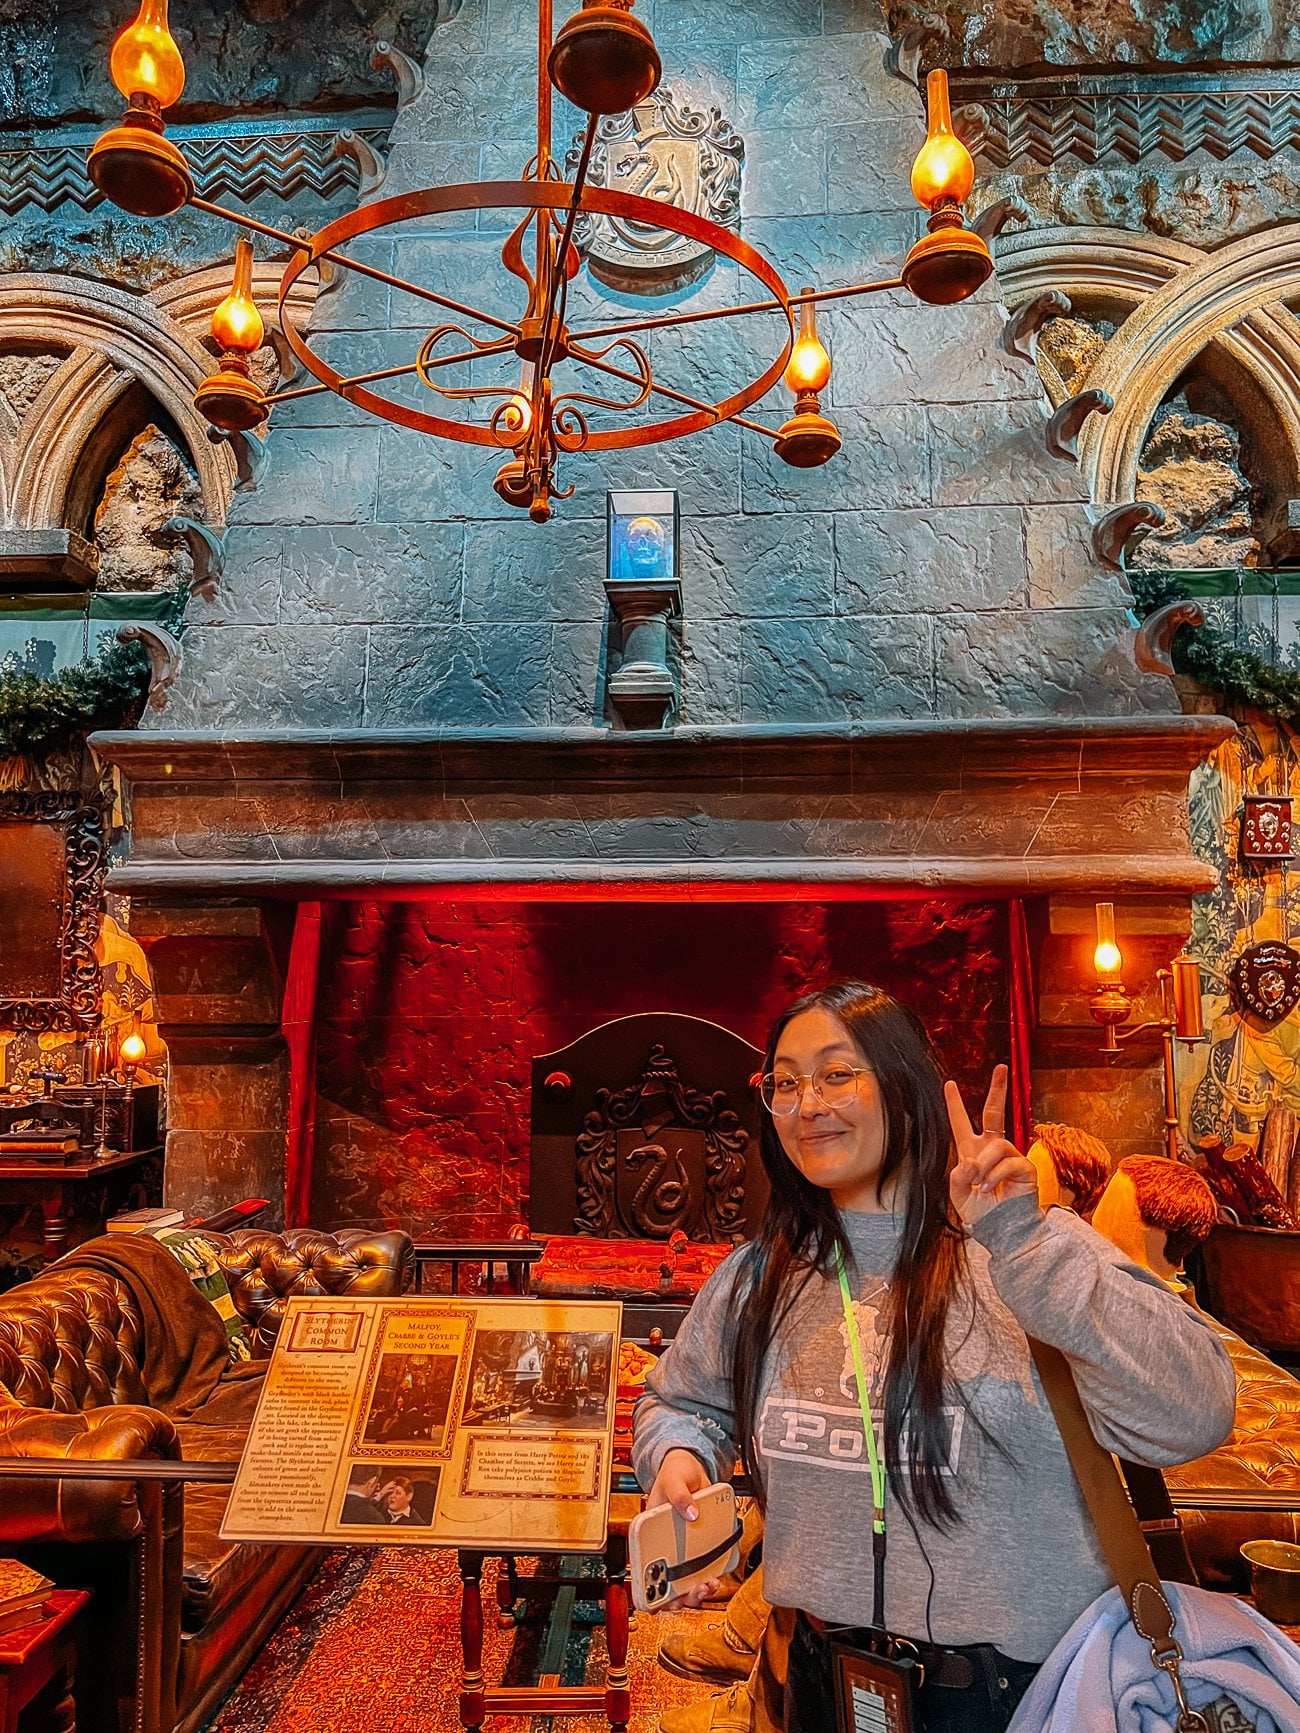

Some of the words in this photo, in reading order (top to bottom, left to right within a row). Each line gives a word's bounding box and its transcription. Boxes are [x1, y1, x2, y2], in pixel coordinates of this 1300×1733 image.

[304, 1316, 354, 1324] SLYTHERIN
[306, 1327, 348, 1335] COMMON
[407, 1323, 442, 1331] MALFOY,
[388, 1332, 417, 1340] CRABBE
[393, 1341, 427, 1349] SECOND
[429, 1342, 450, 1350] YEAR
[530, 1452, 547, 1461] Harry
